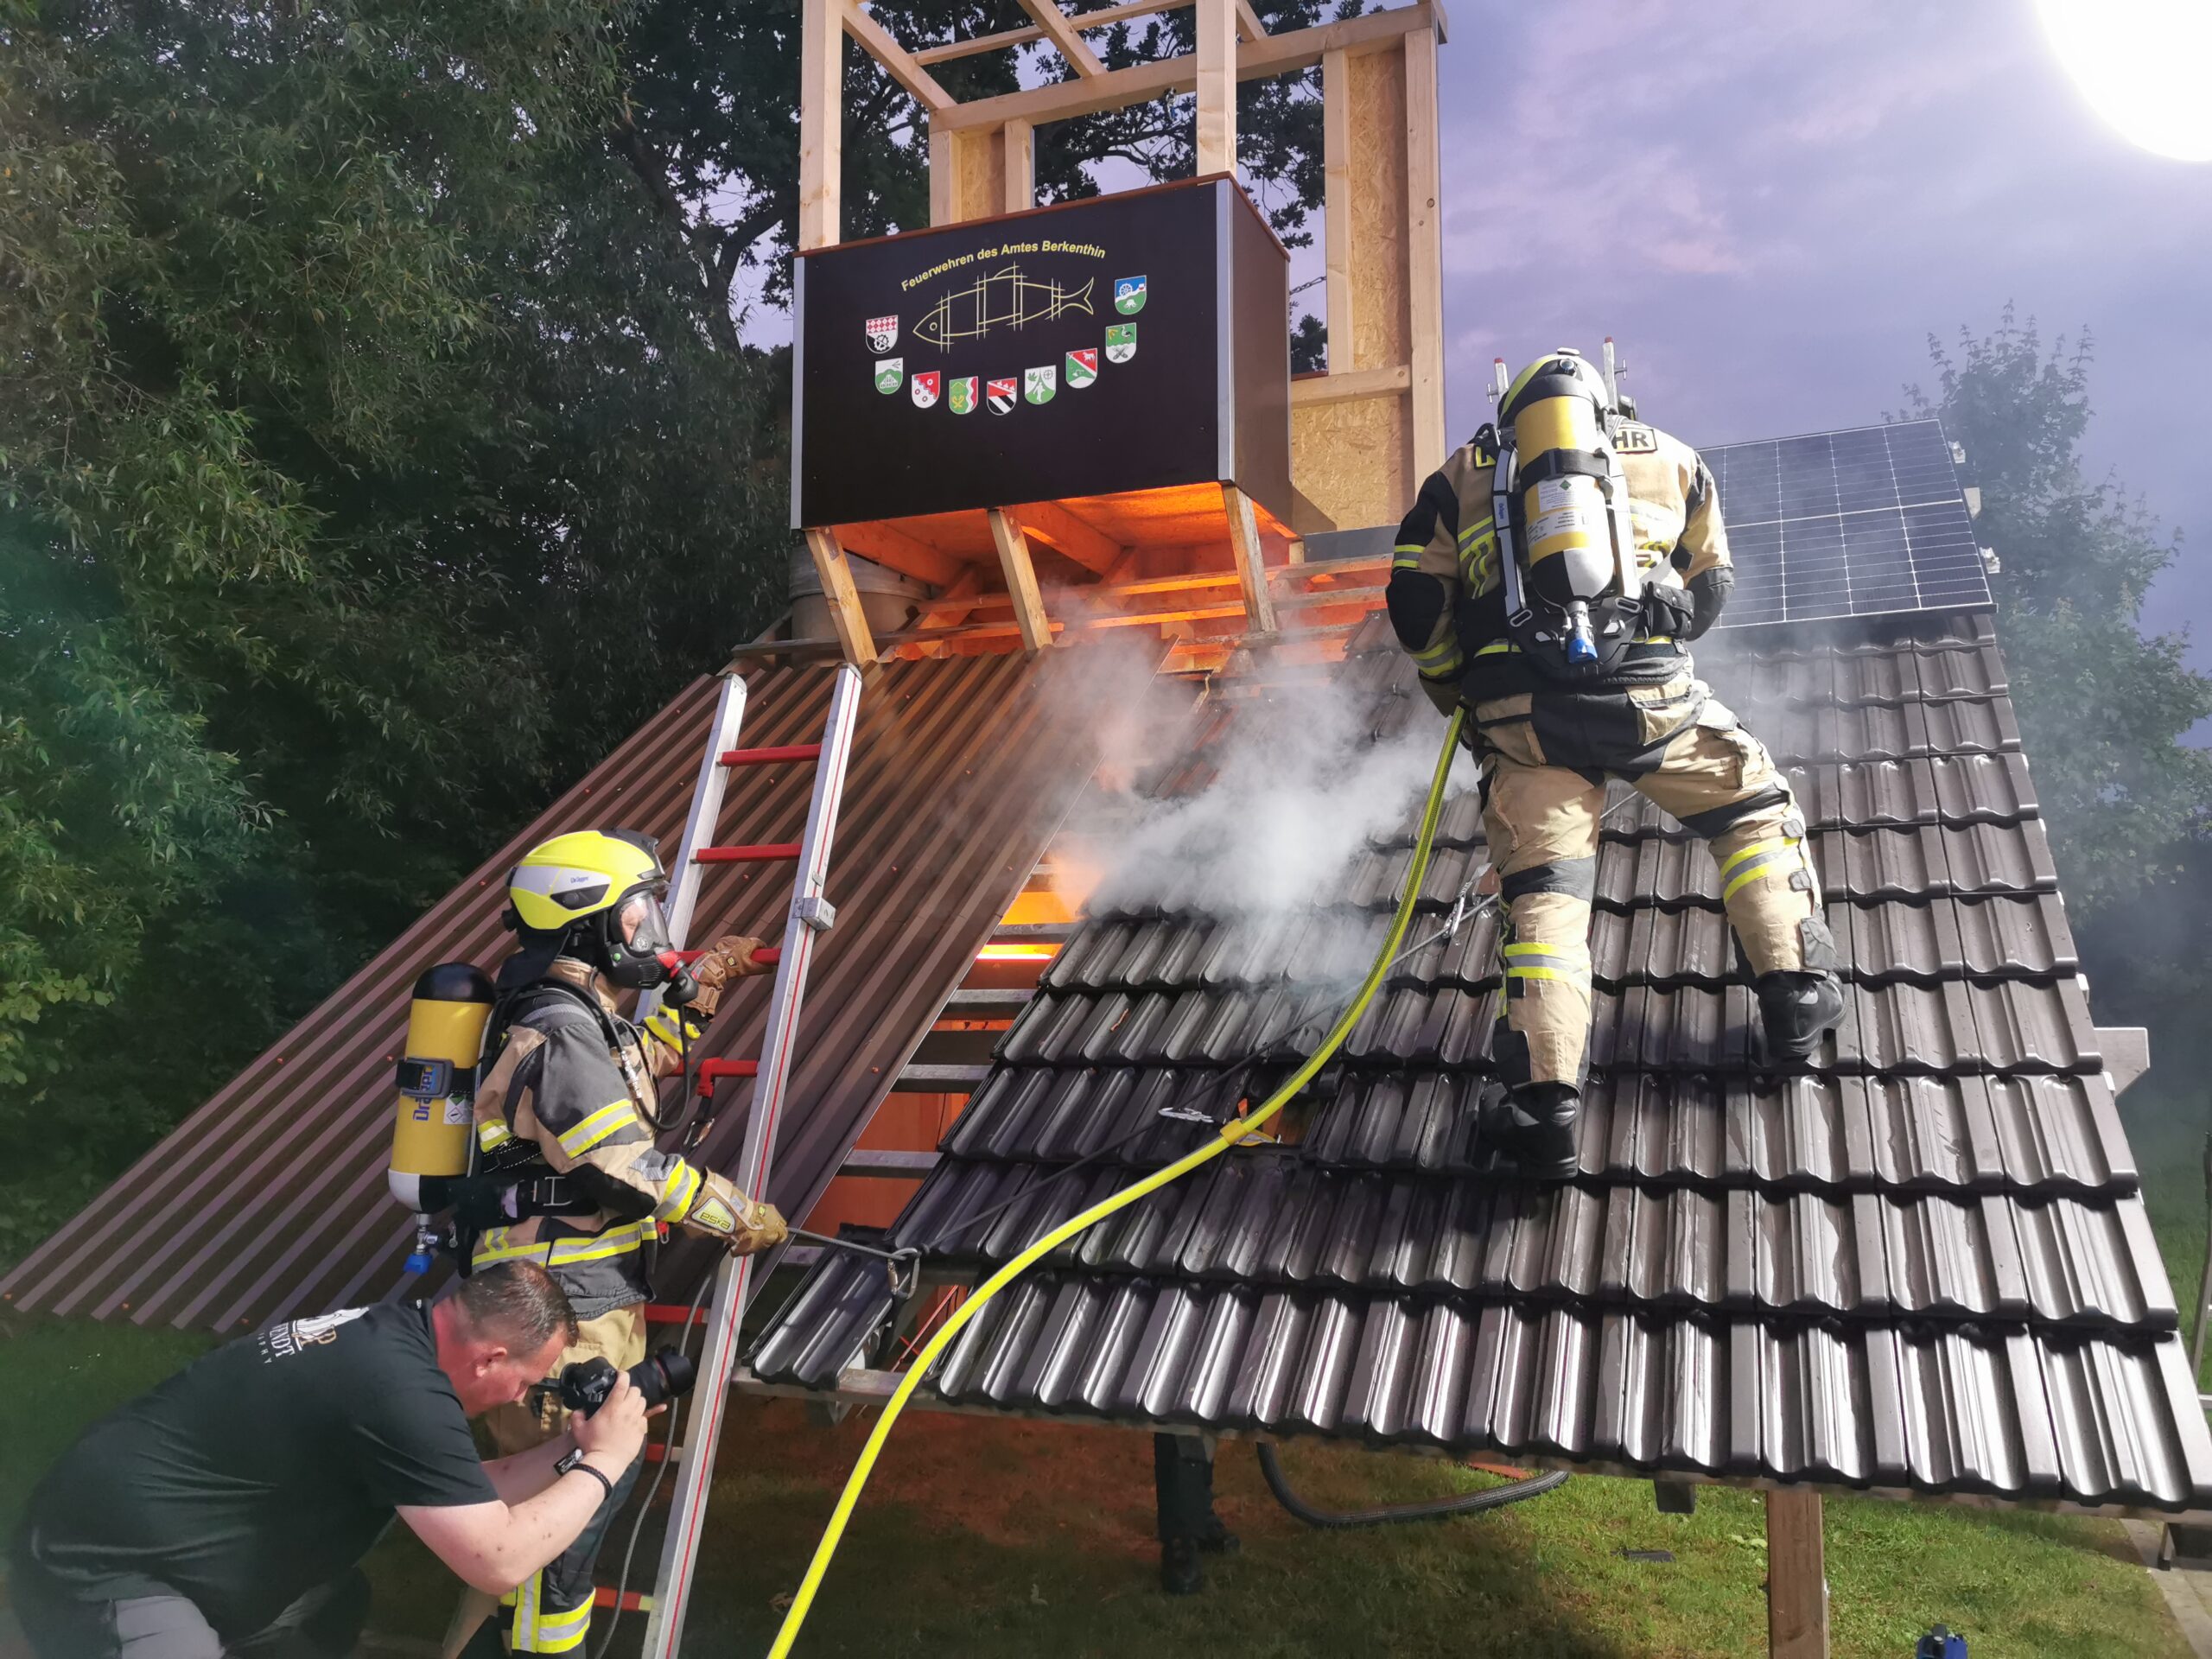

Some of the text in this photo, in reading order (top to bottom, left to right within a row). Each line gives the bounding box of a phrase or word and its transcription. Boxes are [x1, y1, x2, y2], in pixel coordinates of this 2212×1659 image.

[900, 239, 1107, 292] Feuerwehren des Amtes Berkenthin
[699, 1211, 731, 1230] eska
